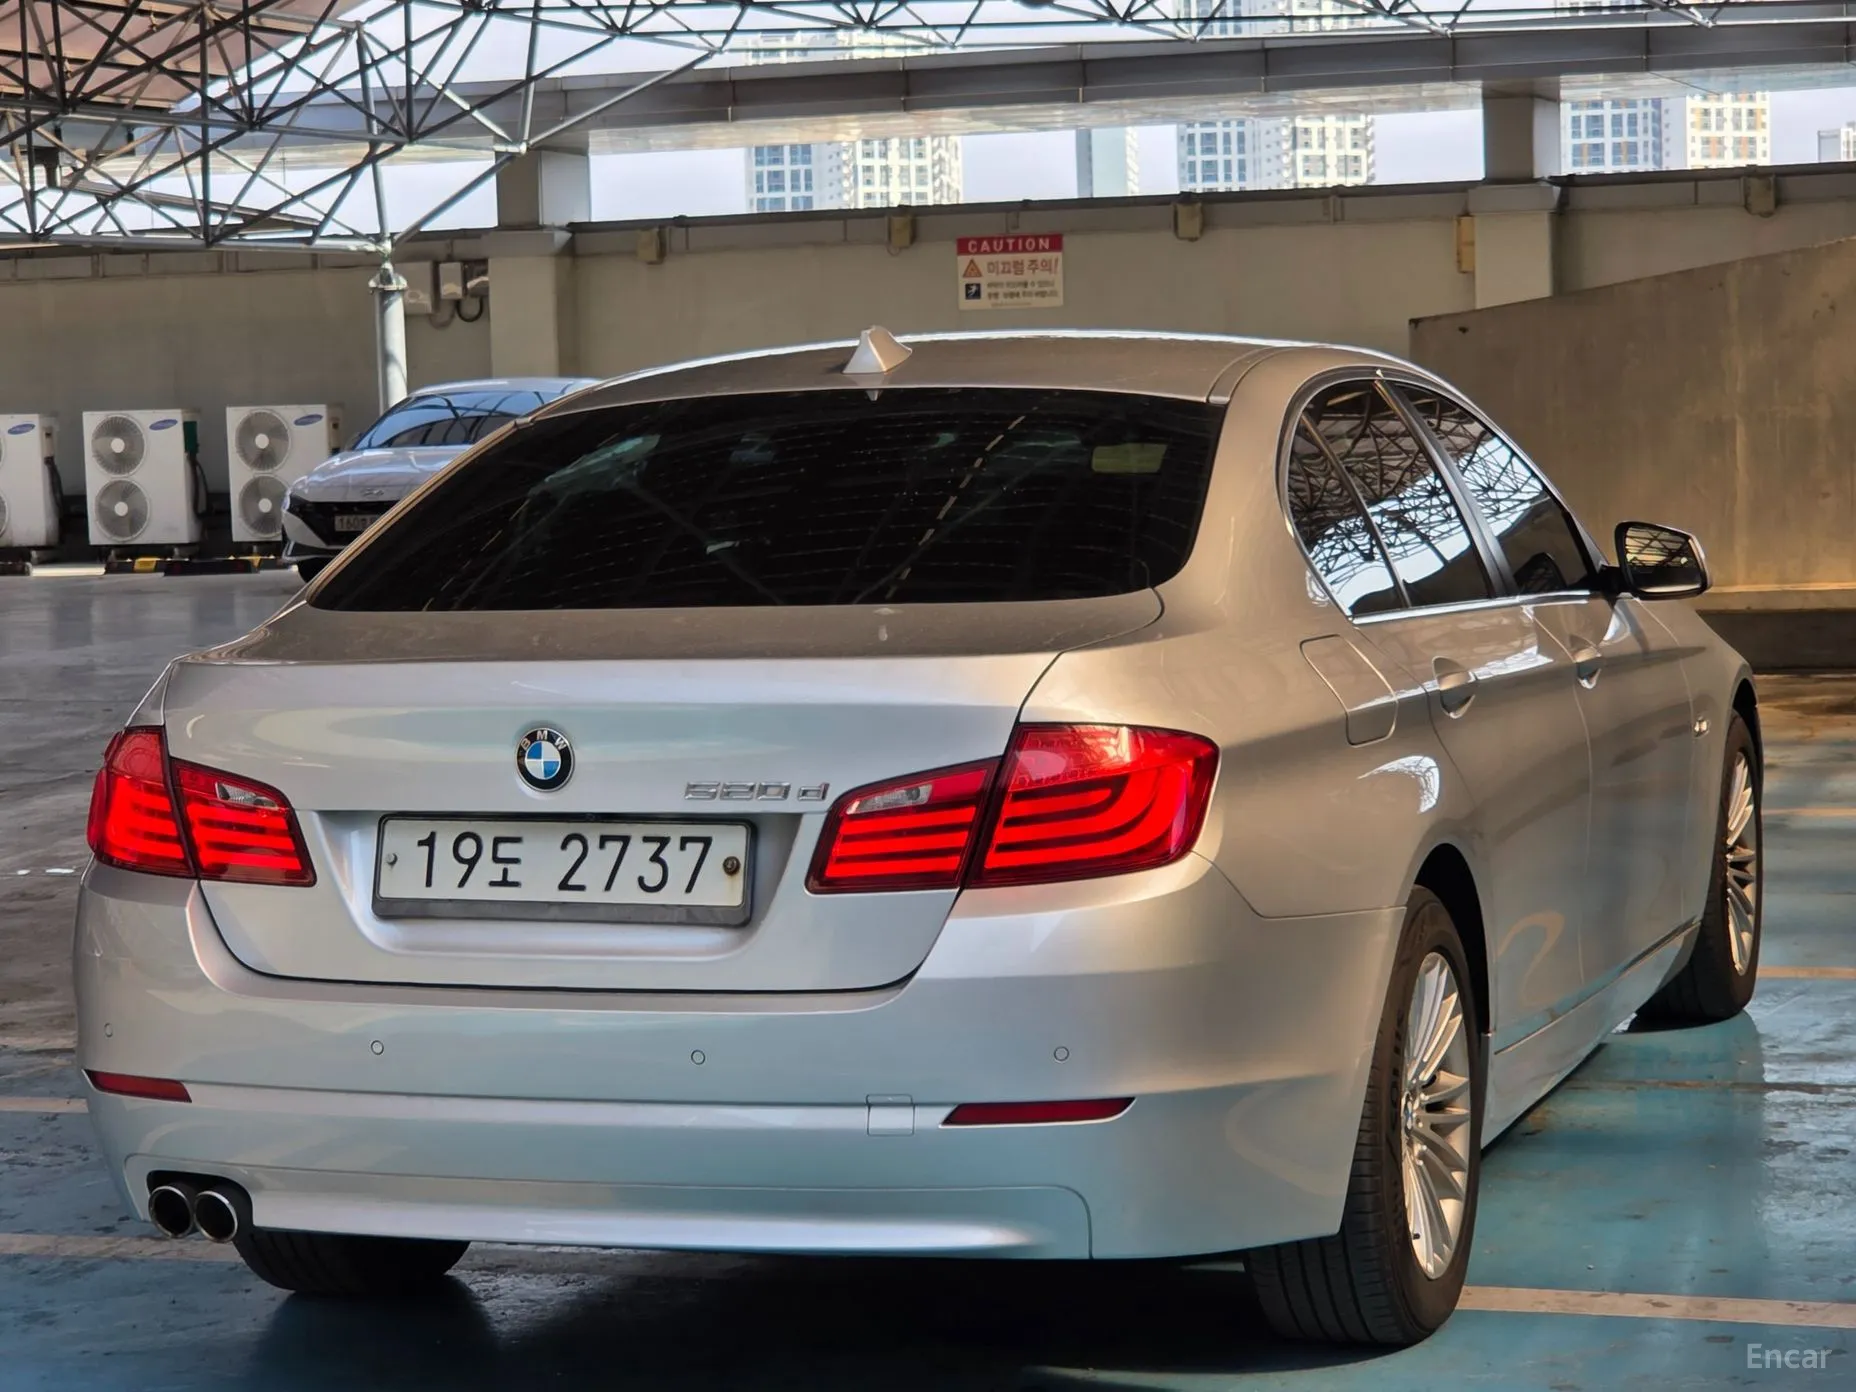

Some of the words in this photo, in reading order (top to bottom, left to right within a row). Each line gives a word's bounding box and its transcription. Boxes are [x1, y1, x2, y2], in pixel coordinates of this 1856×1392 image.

[967, 238, 1050, 253] CAUTION
[987, 260, 1024, 276] 미끄럼
[520, 730, 567, 751] BMW
[417, 831, 523, 888] 19도
[558, 832, 713, 894] 2737
